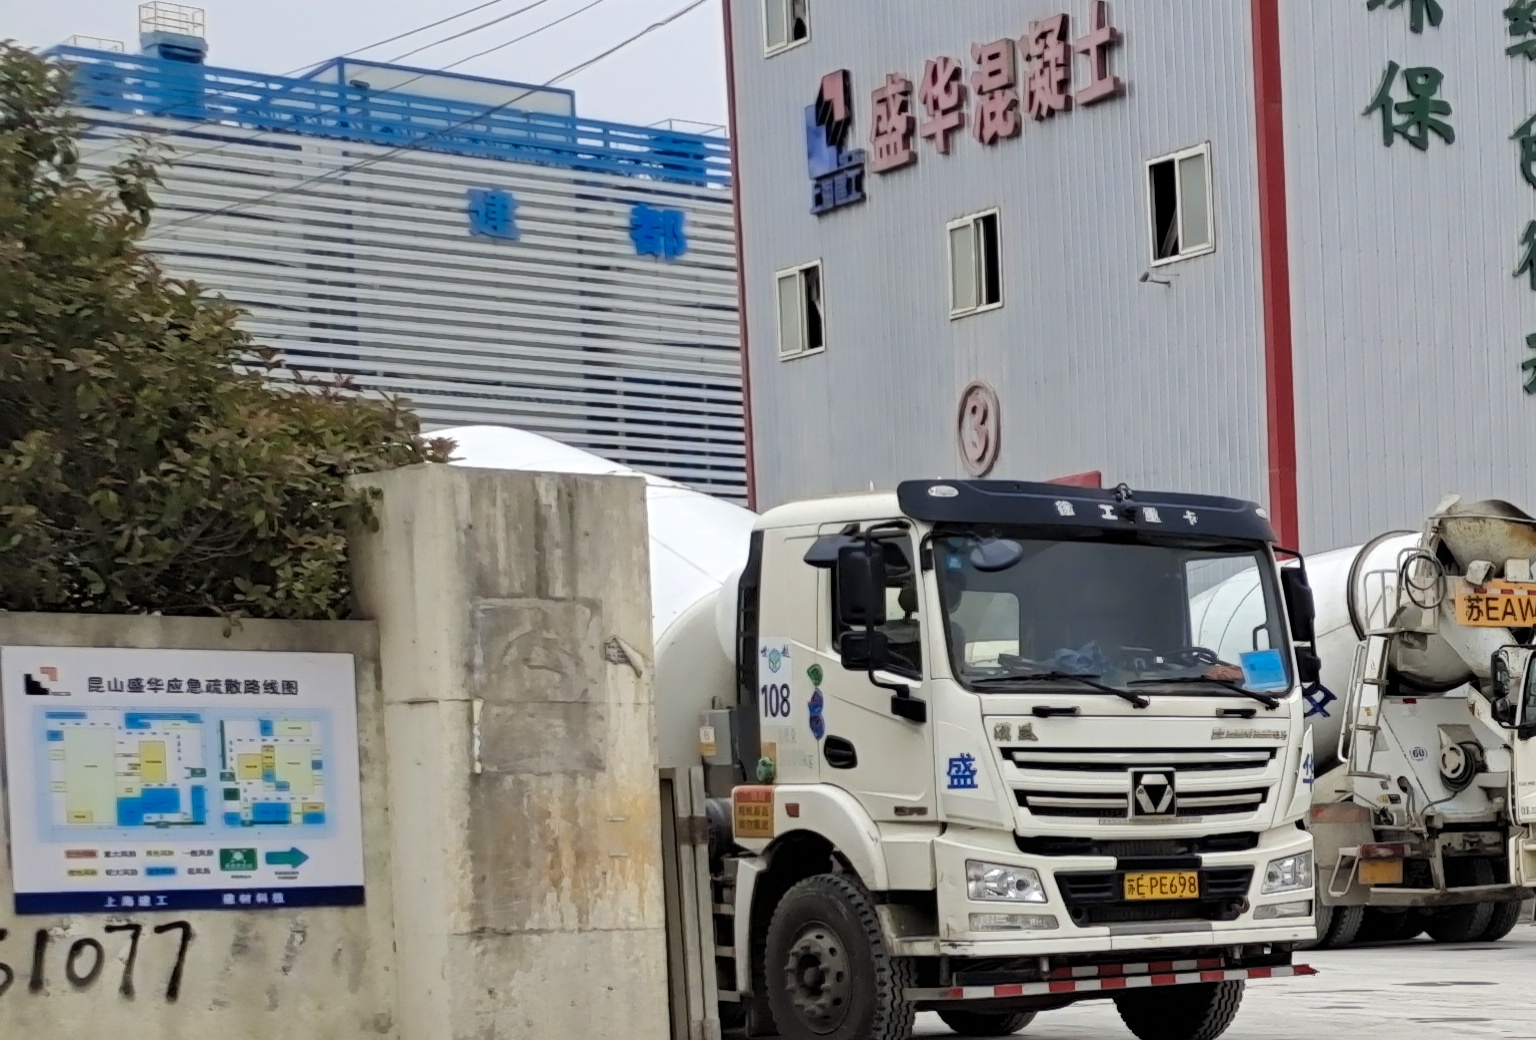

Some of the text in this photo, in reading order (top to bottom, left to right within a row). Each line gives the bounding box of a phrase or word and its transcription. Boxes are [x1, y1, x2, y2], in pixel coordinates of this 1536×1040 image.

[870, 0, 1126, 173] 盛华混凝土
[88, 675, 299, 696] 昆山盛华应急疏散路线图
[761, 683, 791, 718] 108
[947, 753, 979, 790] 盛
